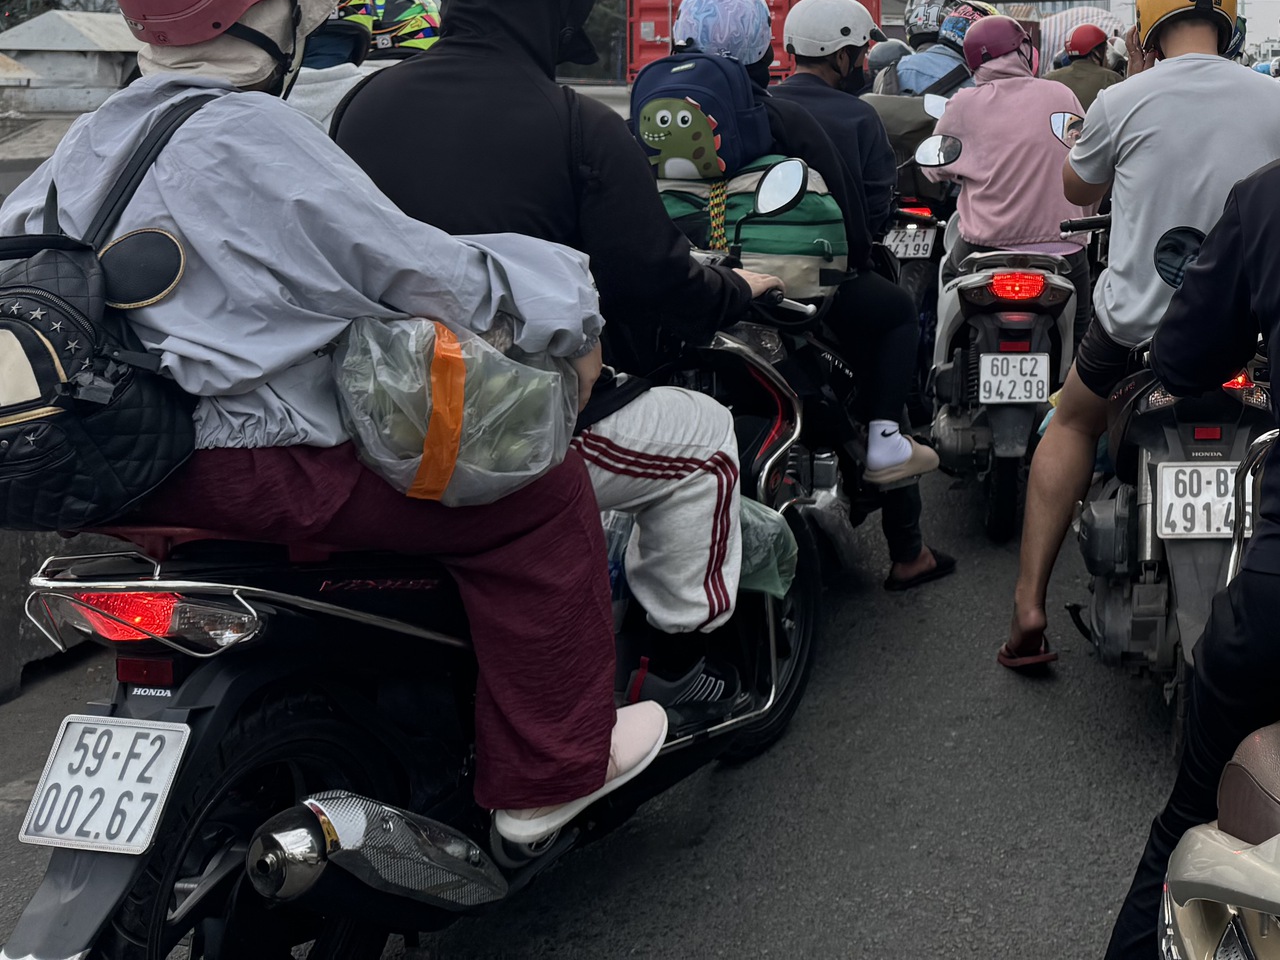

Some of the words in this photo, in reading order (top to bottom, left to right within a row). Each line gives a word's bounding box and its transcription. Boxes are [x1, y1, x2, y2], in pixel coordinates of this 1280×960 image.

[909, 5, 940, 26] 41
[892, 230, 928, 243] 72-F1
[888, 243, 930, 257] 41.99
[990, 357, 1039, 378] 60-C2
[983, 380, 1045, 400] 942.98
[132, 687, 172, 697] HONDA
[67, 726, 167, 784] 59-F2
[33, 782, 159, 843] 002.67
